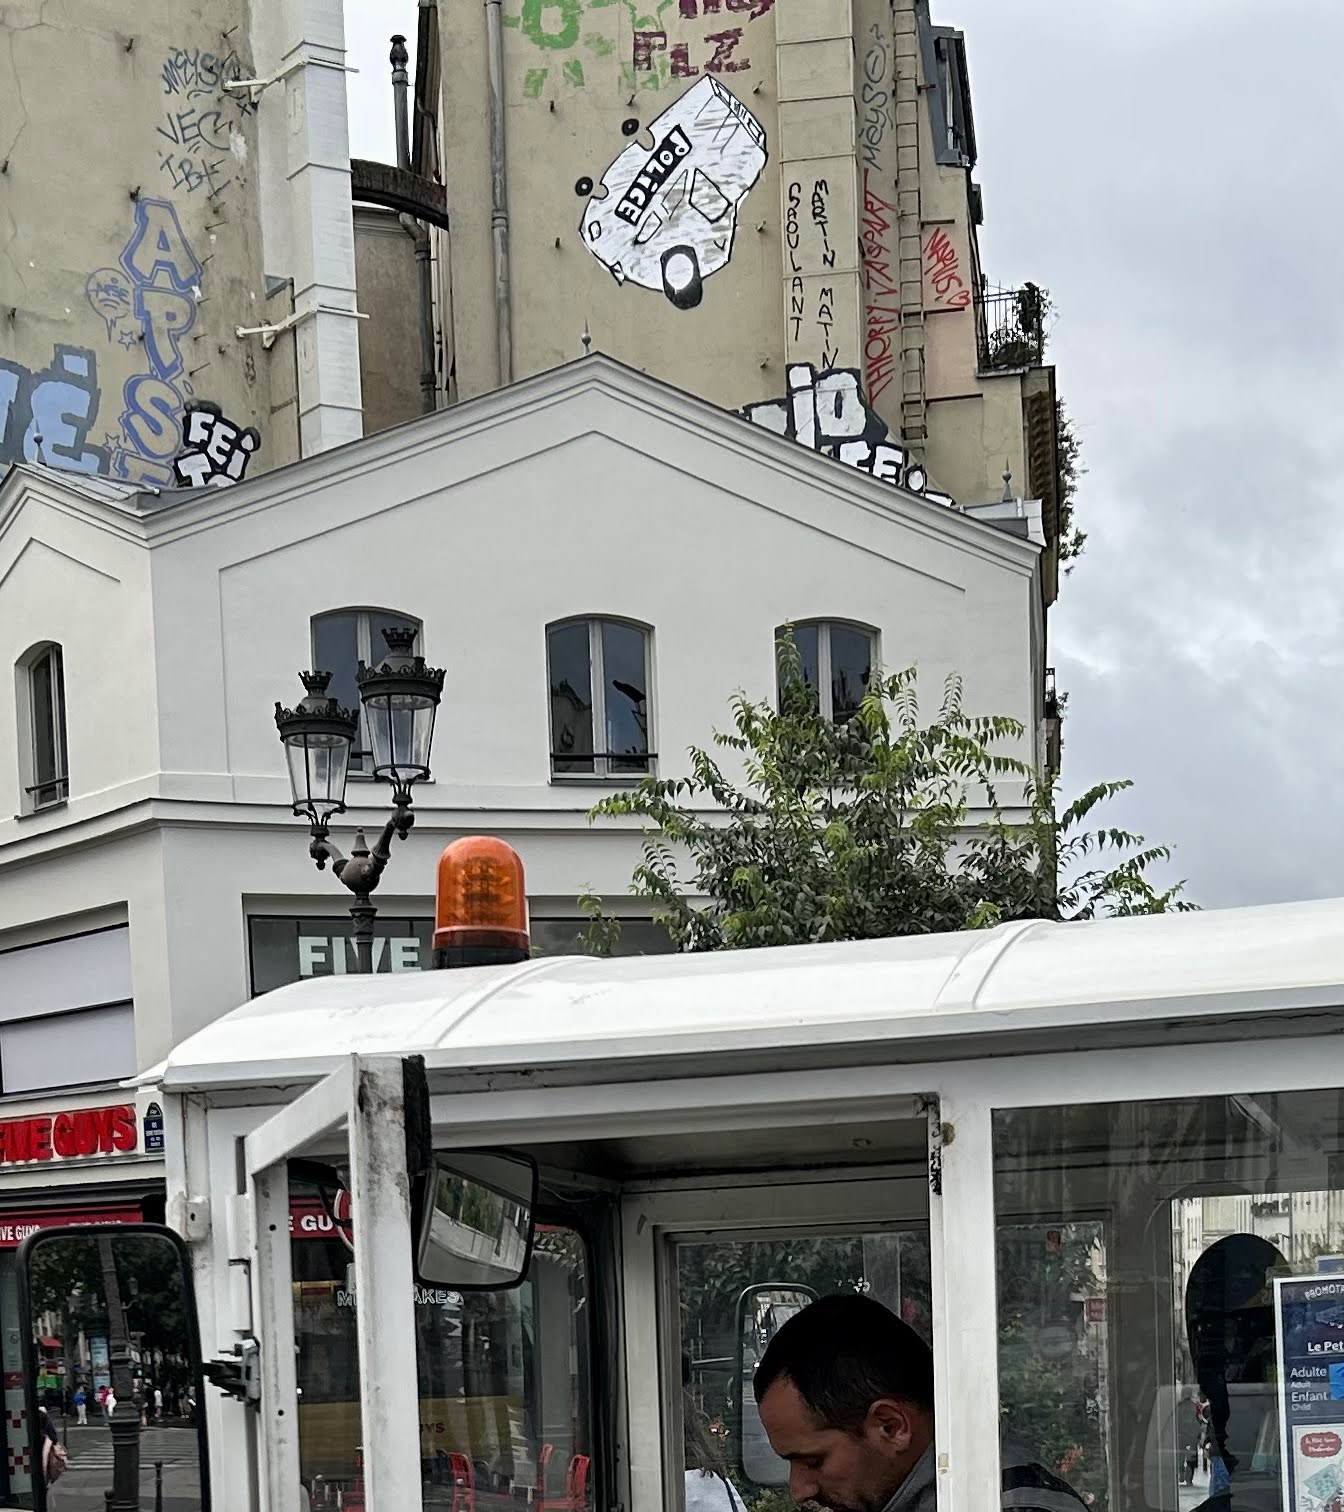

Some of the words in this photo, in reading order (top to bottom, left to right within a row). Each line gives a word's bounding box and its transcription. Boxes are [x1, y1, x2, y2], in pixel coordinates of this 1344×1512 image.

[618, 127, 691, 223] POLICE
[298, 935, 423, 976] FIVE
[53, 1105, 138, 1157] GUYS
[1308, 1341, 1322, 1353] Le
[1290, 1367, 1327, 1379] Adulte
[1291, 1391, 1328, 1403] Enfant
